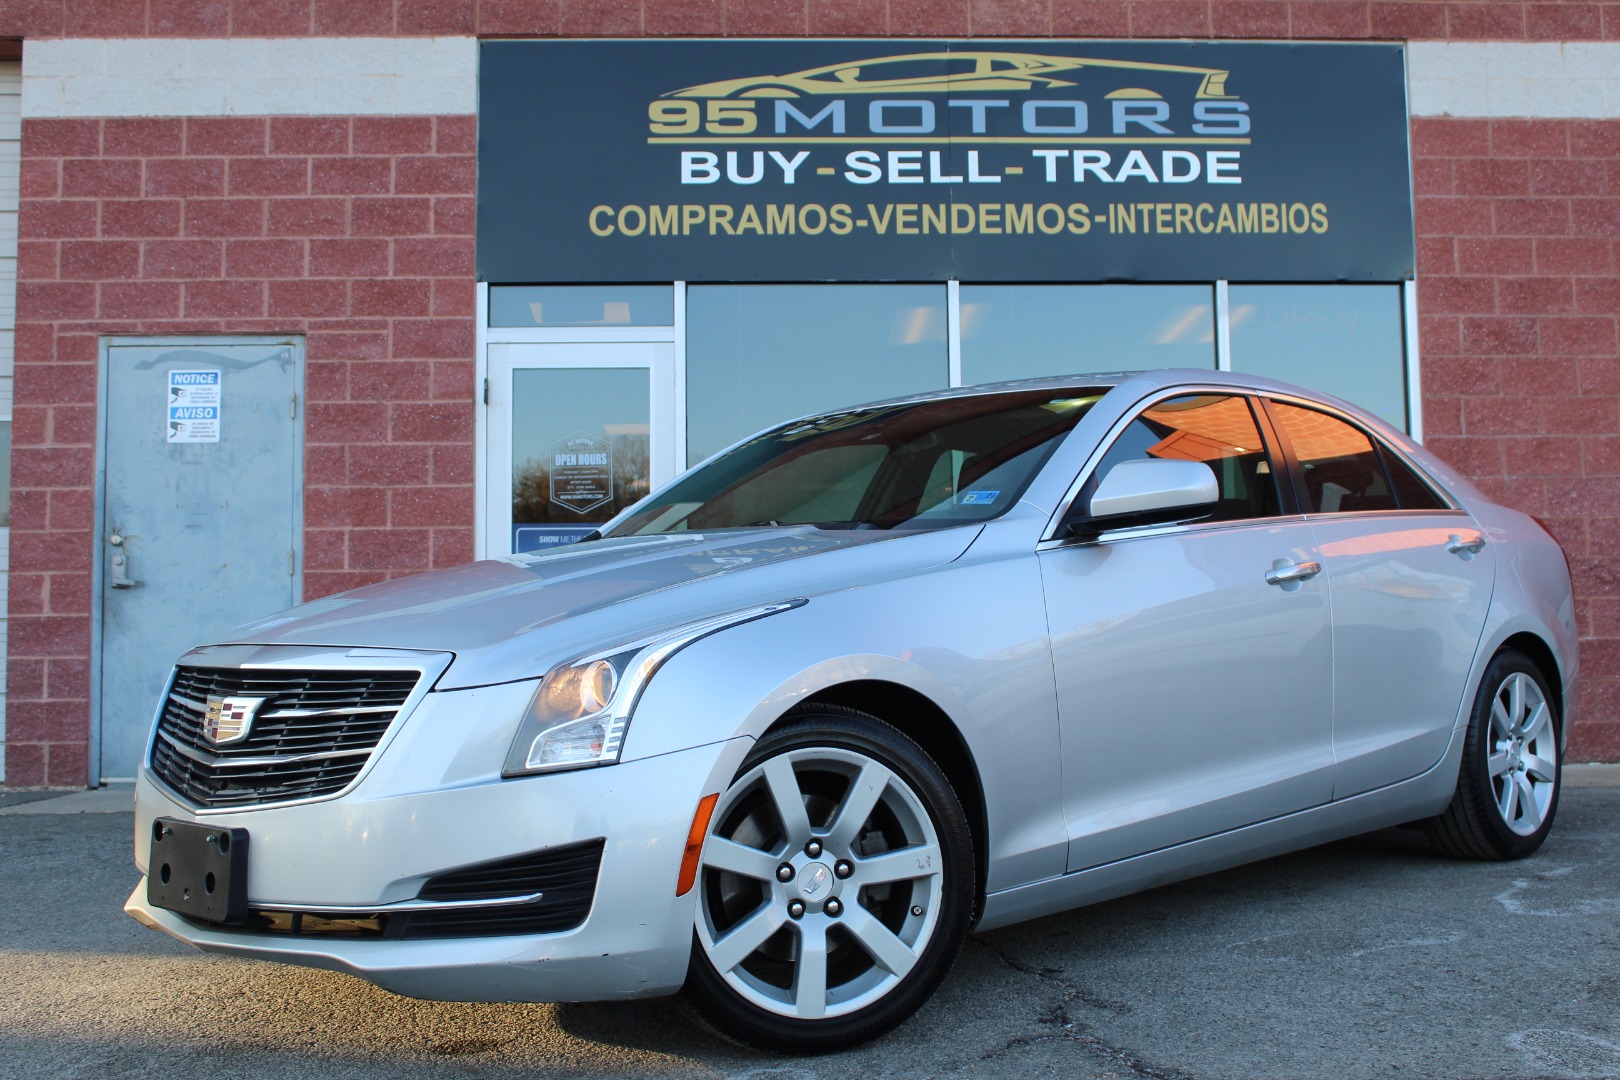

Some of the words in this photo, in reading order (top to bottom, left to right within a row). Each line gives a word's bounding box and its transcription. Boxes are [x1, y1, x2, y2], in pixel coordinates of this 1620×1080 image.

[174, 374, 215, 384] NOTICE
[174, 408, 213, 418] AVISO
[555, 453, 577, 466] OPEN
[578, 453, 607, 466] HOURS
[539, 535, 560, 543] SHOW
[560, 535, 570, 543] ME
